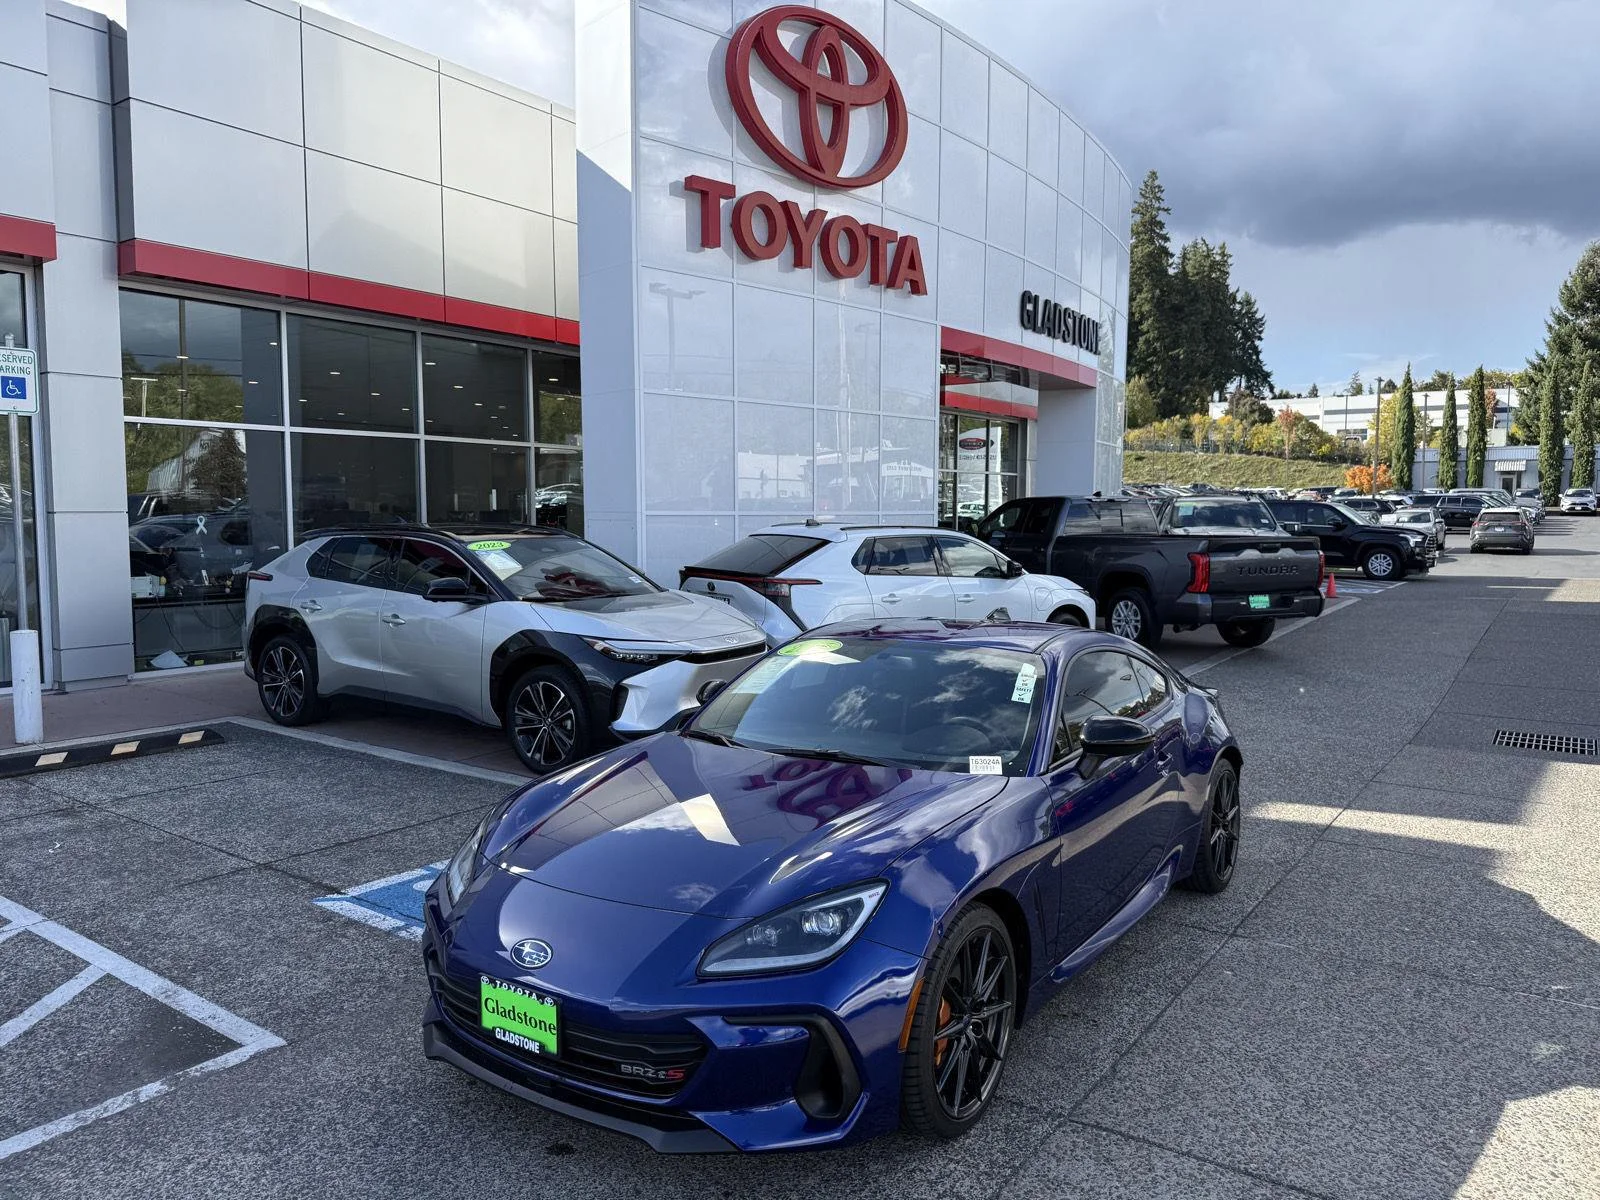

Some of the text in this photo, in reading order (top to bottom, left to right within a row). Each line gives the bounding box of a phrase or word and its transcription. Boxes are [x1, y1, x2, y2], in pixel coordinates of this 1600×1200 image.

[684, 174, 928, 296] TOYOTA
[1020, 290, 1102, 356] GLADSTONE
[0, 354, 33, 365] SERVED
[475, 541, 504, 550] 2023
[1237, 564, 1299, 576] TUNDRA
[971, 758, 1000, 766] T63024A
[495, 980, 538, 1001] TOYOTA
[484, 997, 556, 1035] Gladstone
[495, 1027, 540, 1054] GLADSTONE
[620, 1064, 656, 1077] BRZ
